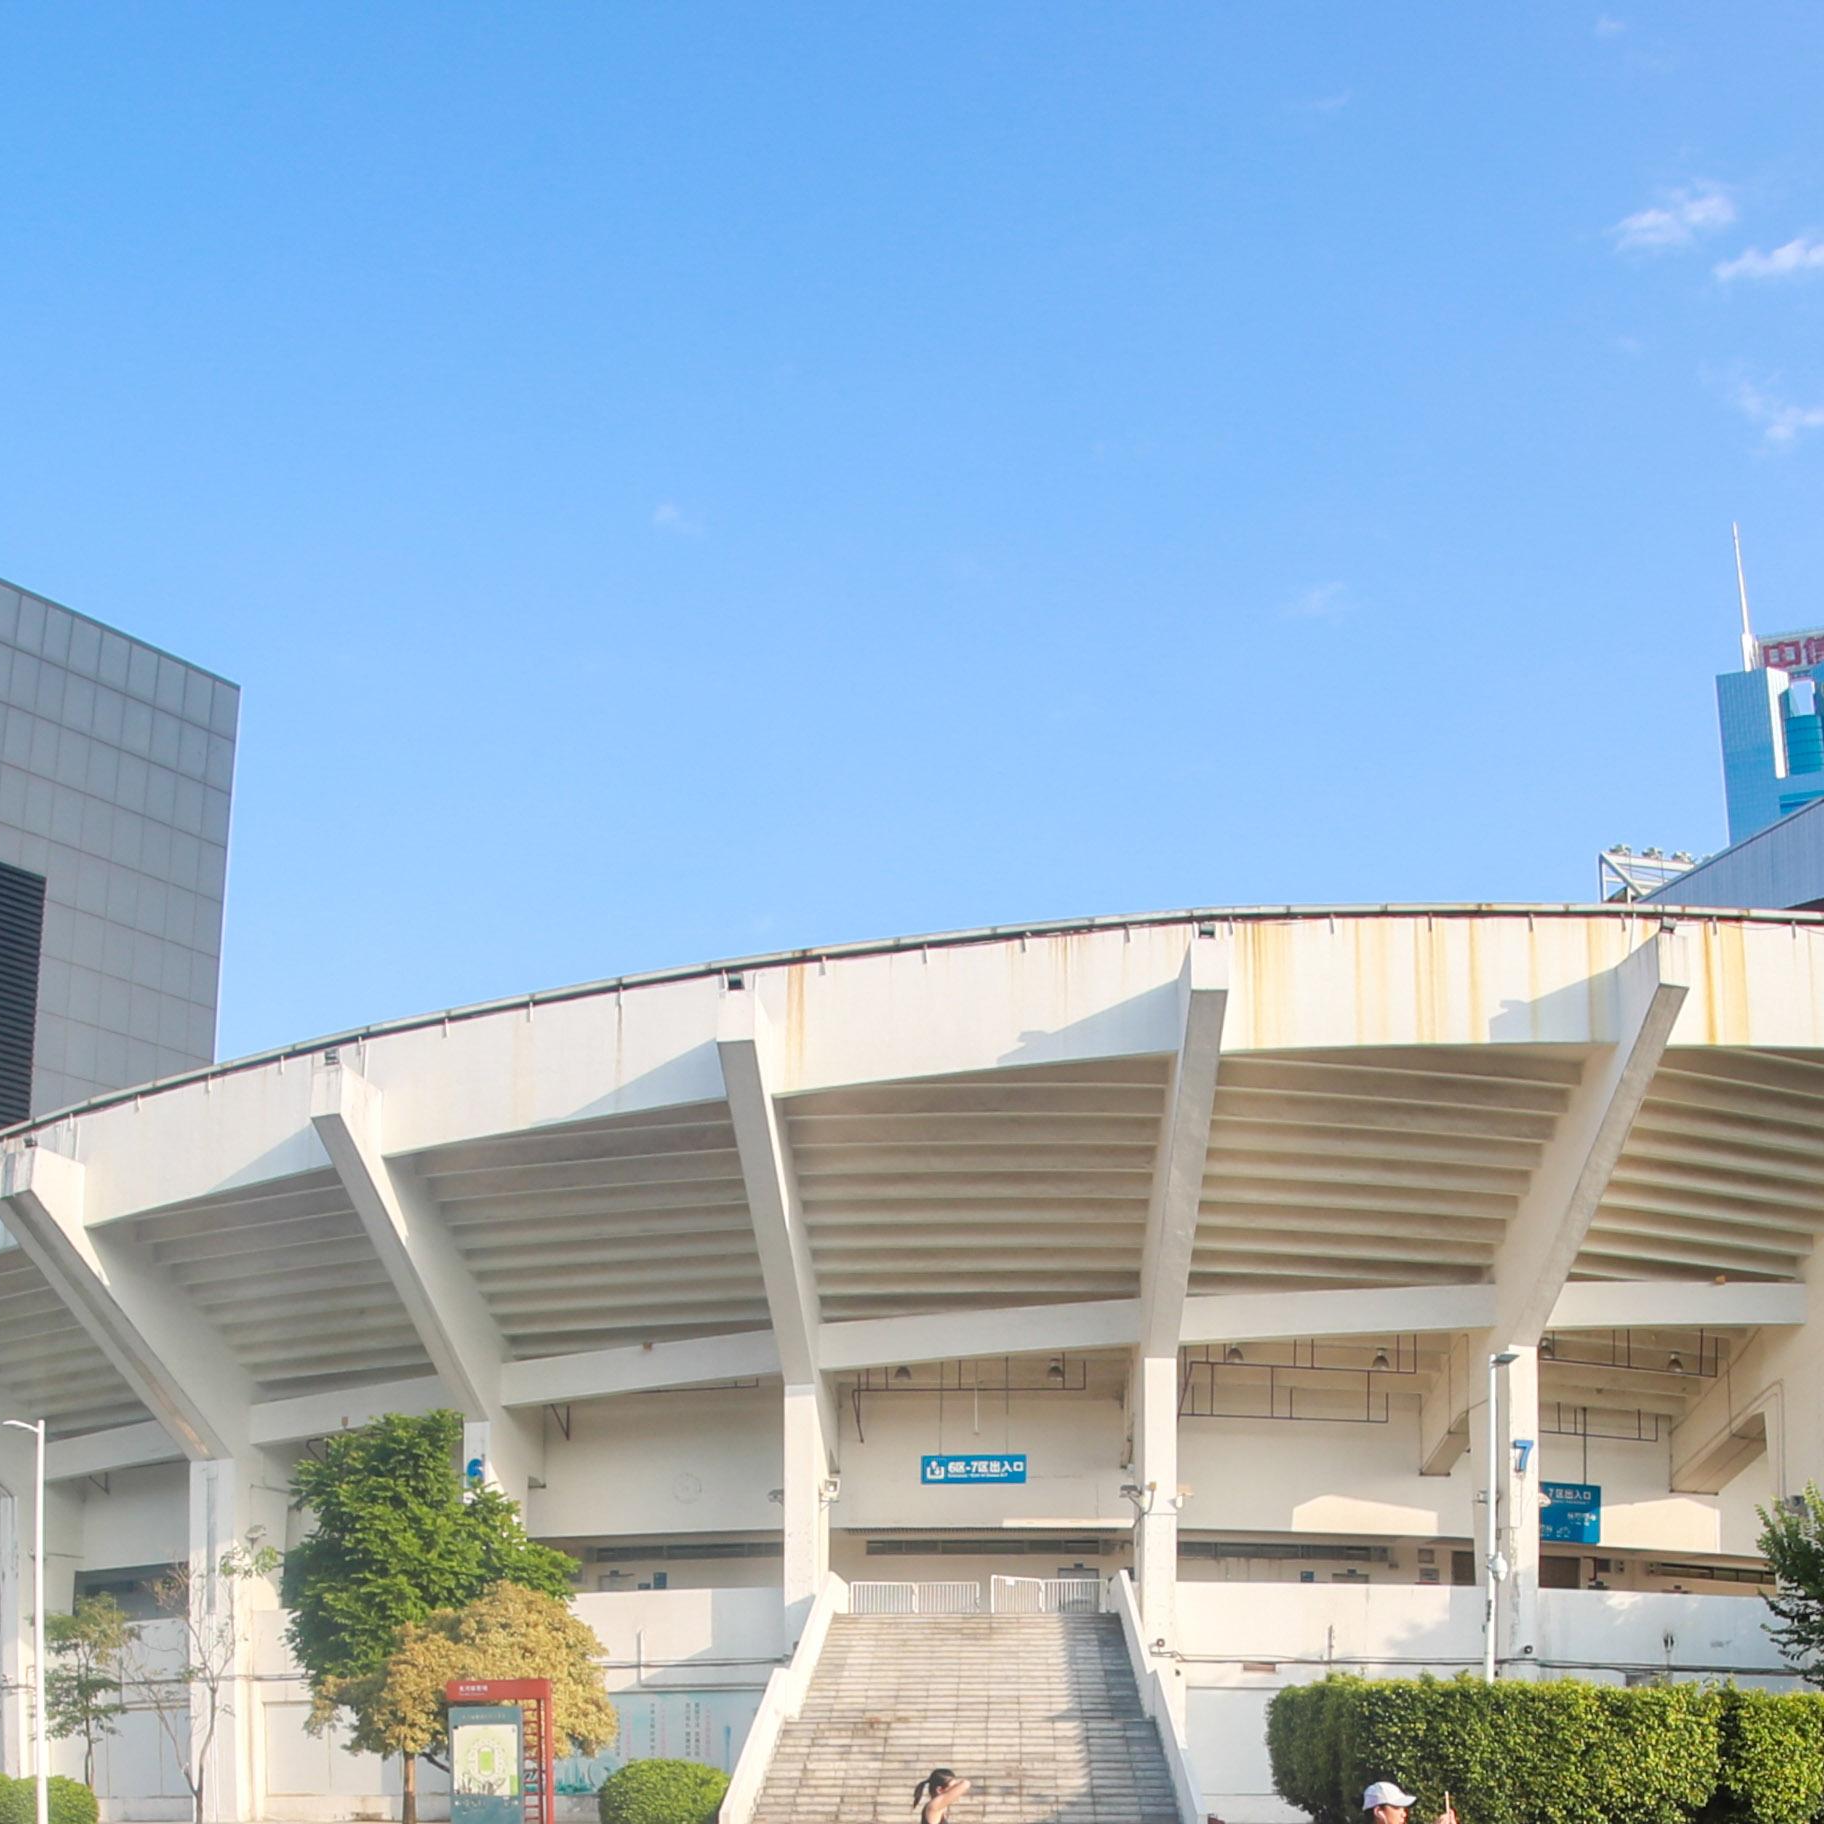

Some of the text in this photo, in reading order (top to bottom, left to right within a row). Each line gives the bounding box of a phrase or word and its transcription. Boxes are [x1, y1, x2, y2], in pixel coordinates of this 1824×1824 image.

[1512, 1439, 1534, 1473] 7
[947, 1460, 1025, 1473] 6区-7区出入口
[1548, 1488, 1591, 1500] 7区出入口
